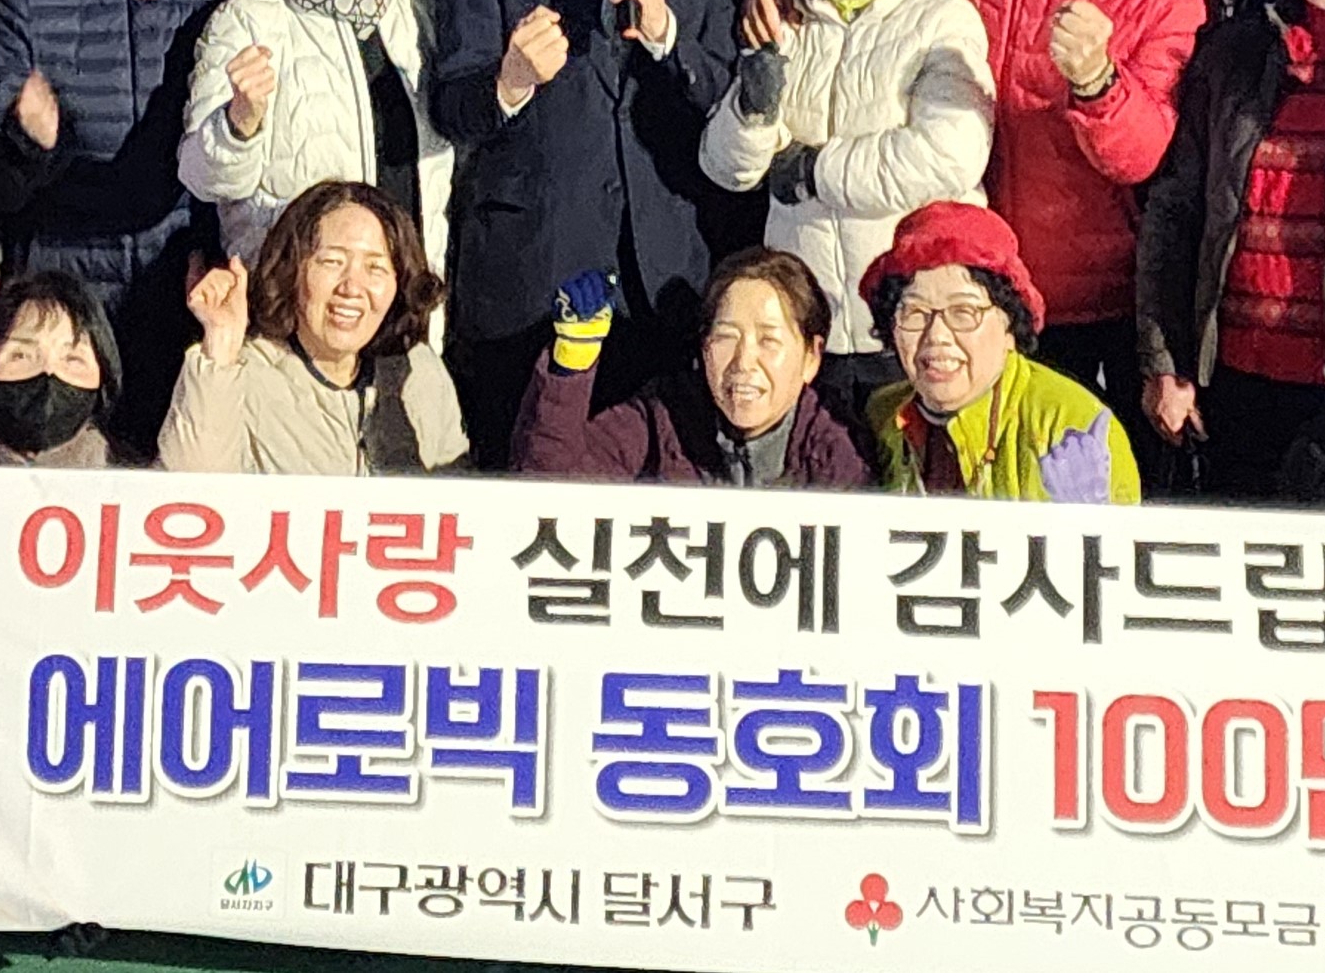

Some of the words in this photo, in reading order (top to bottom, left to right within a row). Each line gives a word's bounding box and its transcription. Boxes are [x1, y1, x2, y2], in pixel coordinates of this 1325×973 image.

[18, 502, 474, 625] 이웃사랑
[512, 516, 841, 634] 실천에
[26, 654, 544, 810] 에어로빅
[591, 668, 984, 826] 동호회
[303, 860, 582, 925] 대구광역시
[603, 871, 777, 931] 달서구
